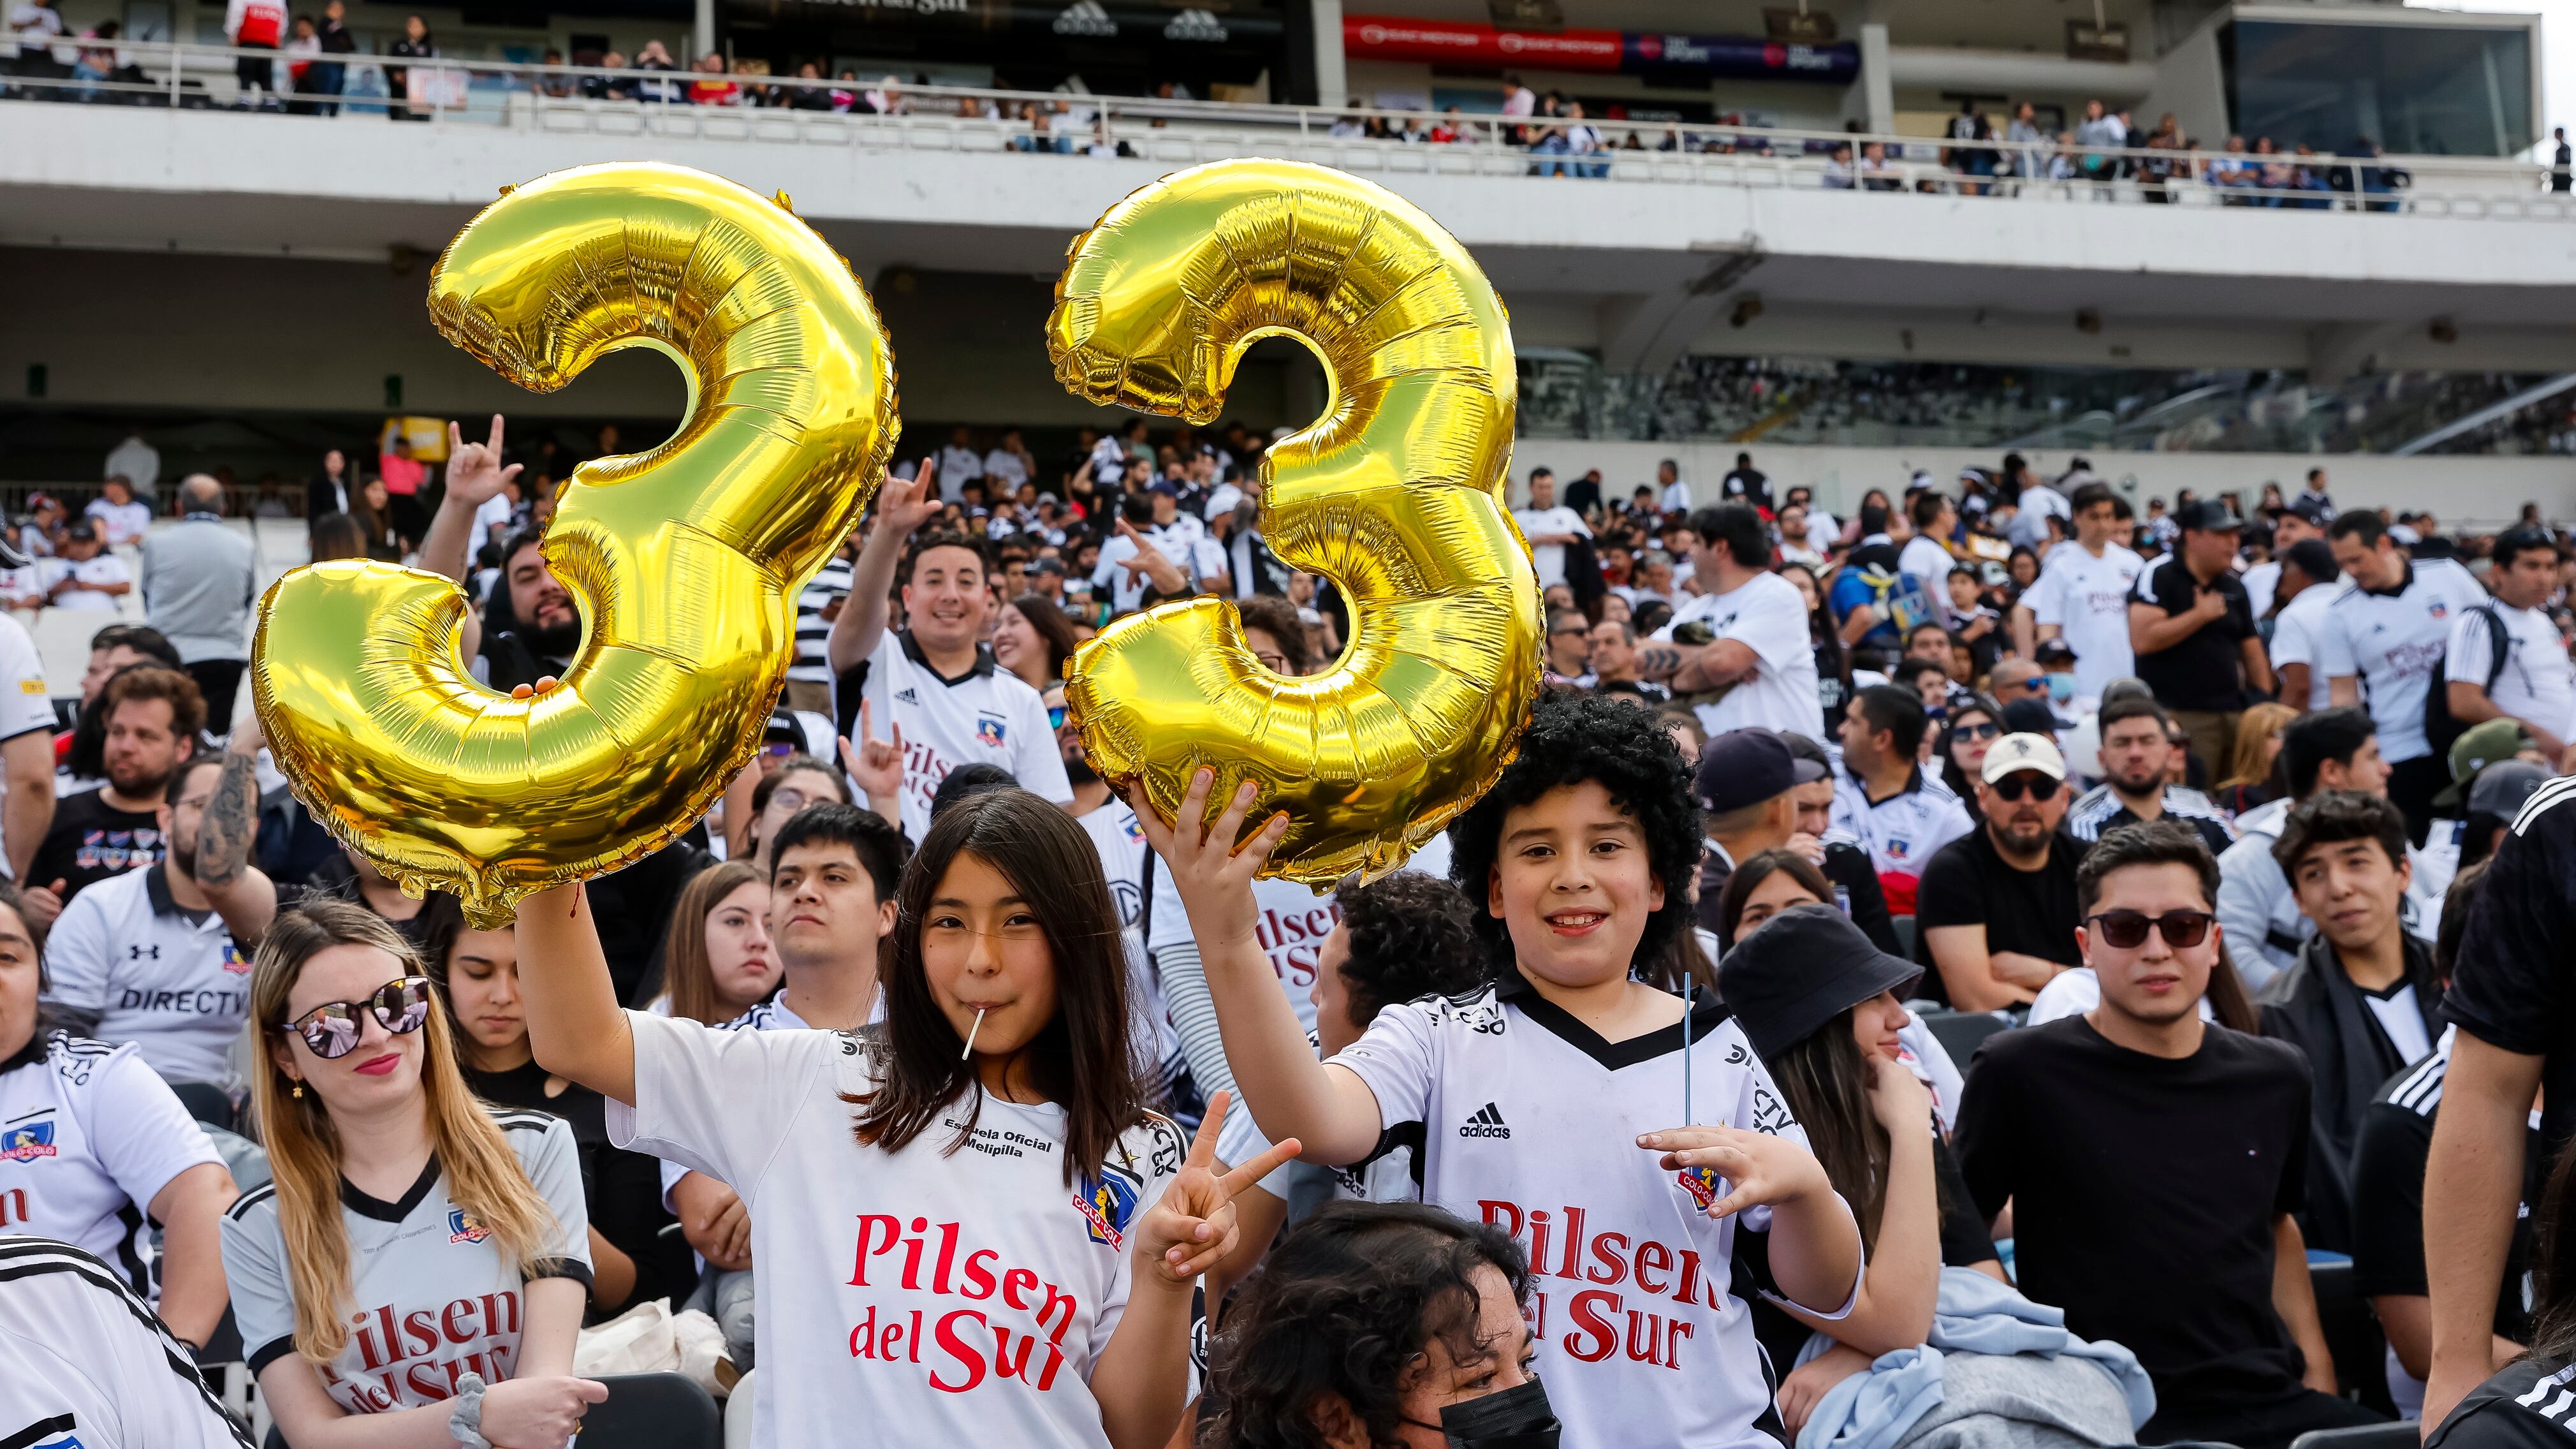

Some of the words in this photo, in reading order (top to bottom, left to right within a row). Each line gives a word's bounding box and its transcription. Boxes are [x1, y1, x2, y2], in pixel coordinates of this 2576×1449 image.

[944, 1118, 999, 1140] Escuela
[1004, 1131, 1052, 1153] Oficial
[963, 1138, 1023, 1158] Melipilla
[1460, 1124, 1511, 1140] adidas
[1151, 1151, 1167, 1177] GO
[1477, 1200, 1722, 1311] Pilsen
[845, 1214, 1077, 1348] Pilsen
[849, 1305, 922, 1364] del
[1563, 1289, 1695, 1371] Sur
